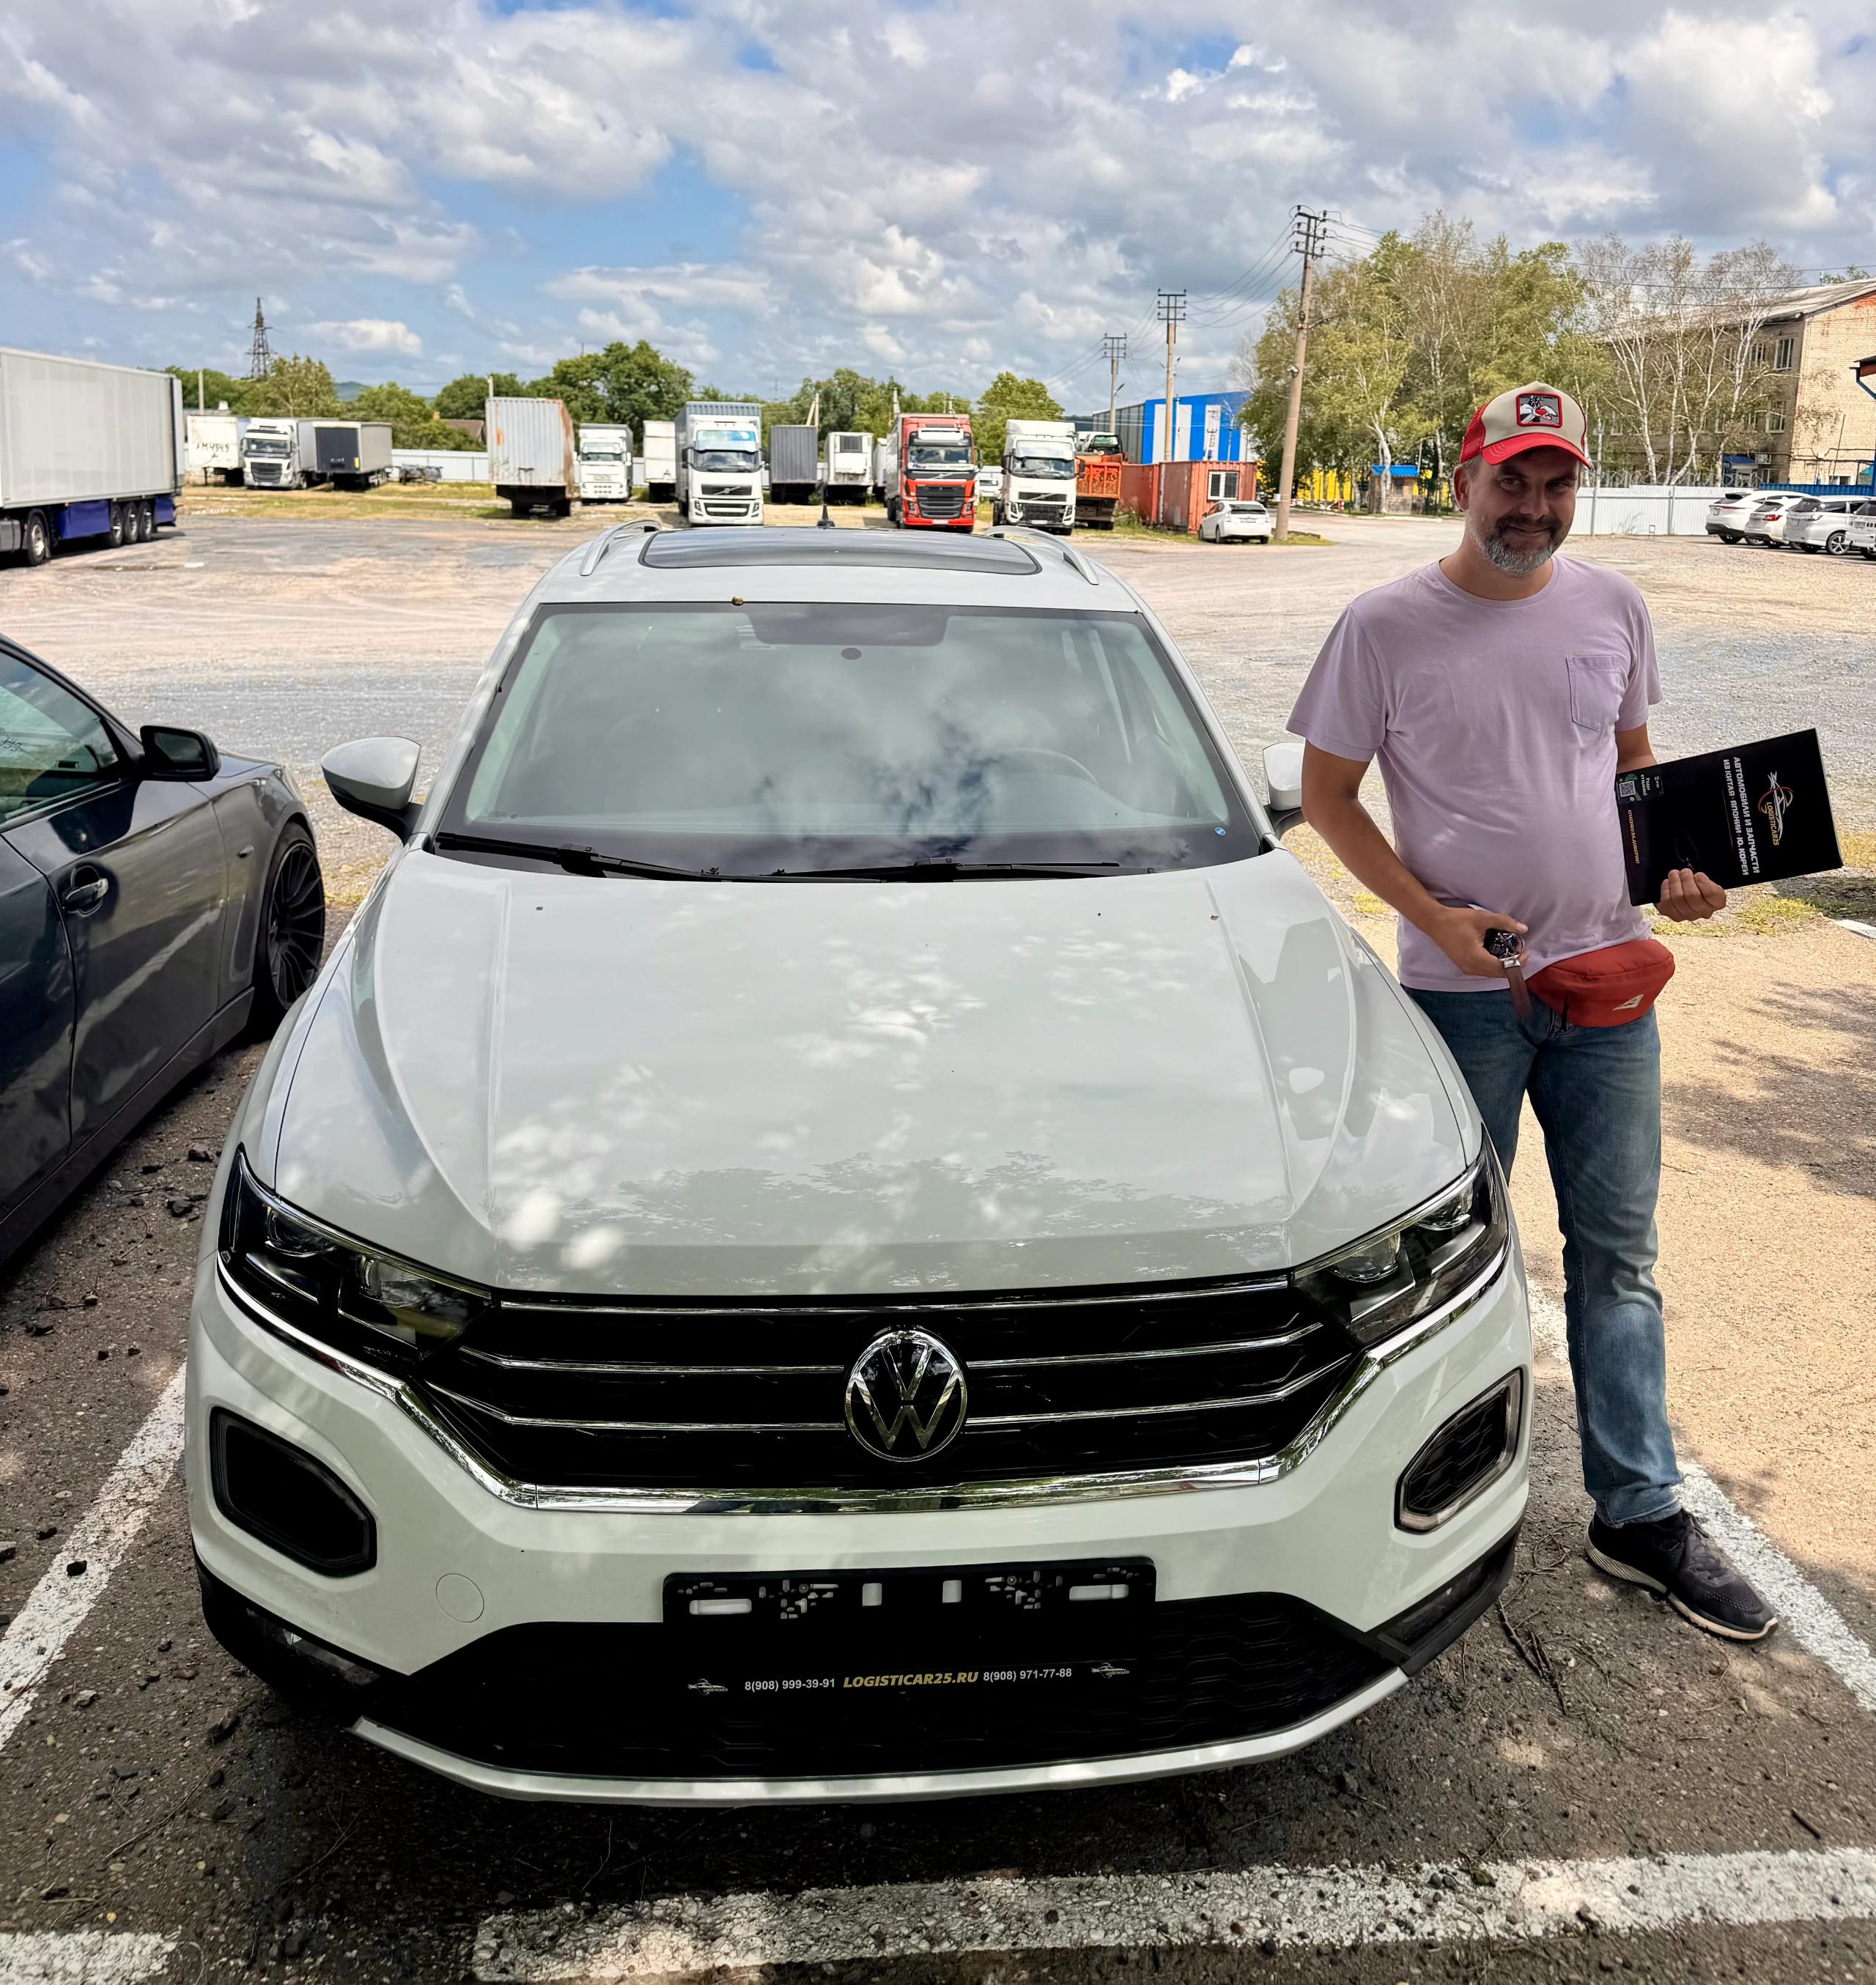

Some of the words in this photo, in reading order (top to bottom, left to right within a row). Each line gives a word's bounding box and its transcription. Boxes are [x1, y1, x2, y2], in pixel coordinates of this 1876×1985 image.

[1723, 759, 1730, 769] ИЗ
[1725, 770, 1735, 796] КИТАЯ
[1730, 799, 1742, 833] ЯПОНИИ
[1733, 756, 1751, 818] АВТОМОБИЛИ
[1746, 827, 1760, 873] ЗАПЧАСТИ
[1766, 802, 1779, 846] LOGISTICAR25
[1737, 837, 1744, 847] Ю.
[1738, 848, 1749, 876] КОРЕИ
[745, 1680, 779, 1693] 8(908)
[782, 1678, 835, 1690] 999-39-91
[843, 1671, 979, 1688] LOGISTICAR25.RU
[983, 1671, 1016, 1683] 8(908)
[1019, 1668, 1072, 1679] 971-77-88
